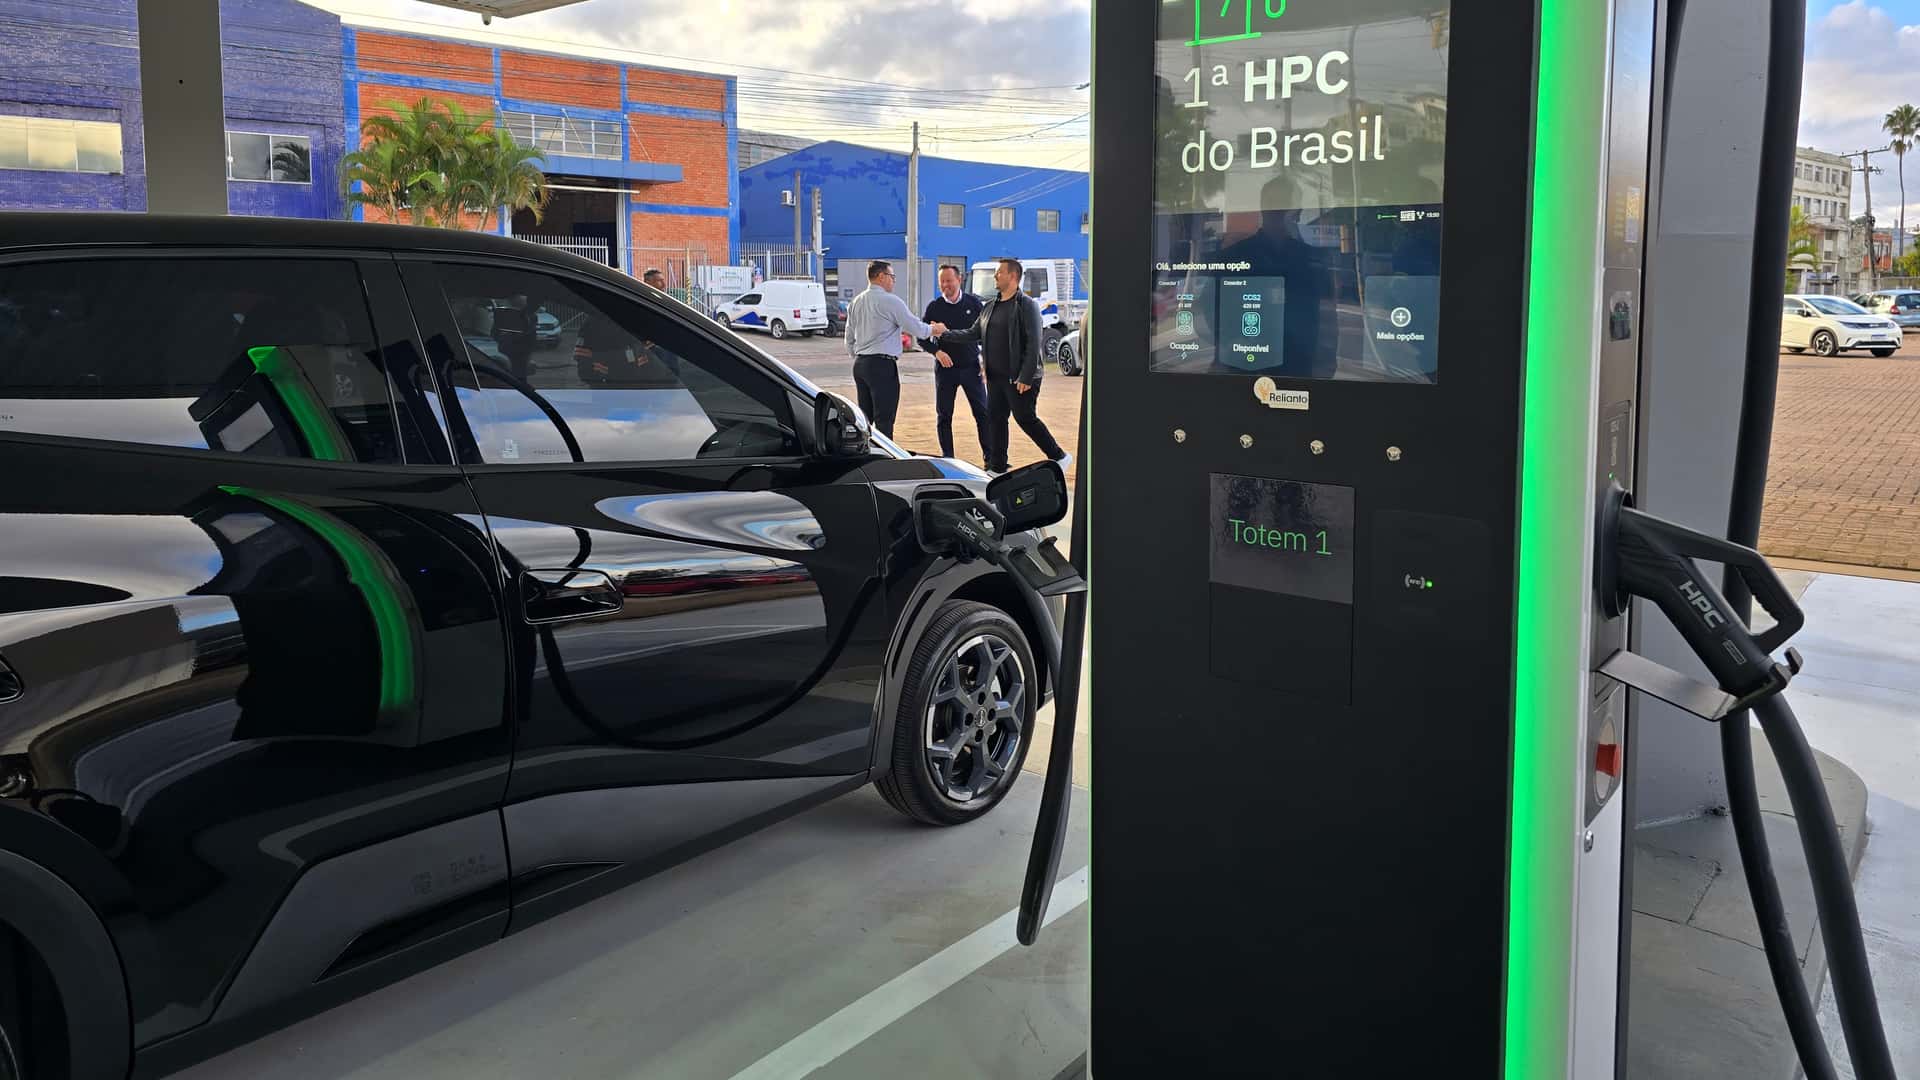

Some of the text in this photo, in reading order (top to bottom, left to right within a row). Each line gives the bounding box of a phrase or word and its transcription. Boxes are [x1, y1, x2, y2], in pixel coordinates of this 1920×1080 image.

[1244, 50, 1350, 103] HPC
[1181, 114, 1386, 174] do Brasil
[1156, 261, 1251, 272] Olá, selecione uma opção
[1376, 331, 1425, 342] Mais opções
[1169, 341, 1200, 351] Ocupado
[1232, 343, 1269, 354] Disponível
[1269, 391, 1308, 404] Relianto
[957, 521, 978, 541] HPC
[1228, 518, 1333, 555] Totem 1
[1679, 580, 1725, 629] HPC
